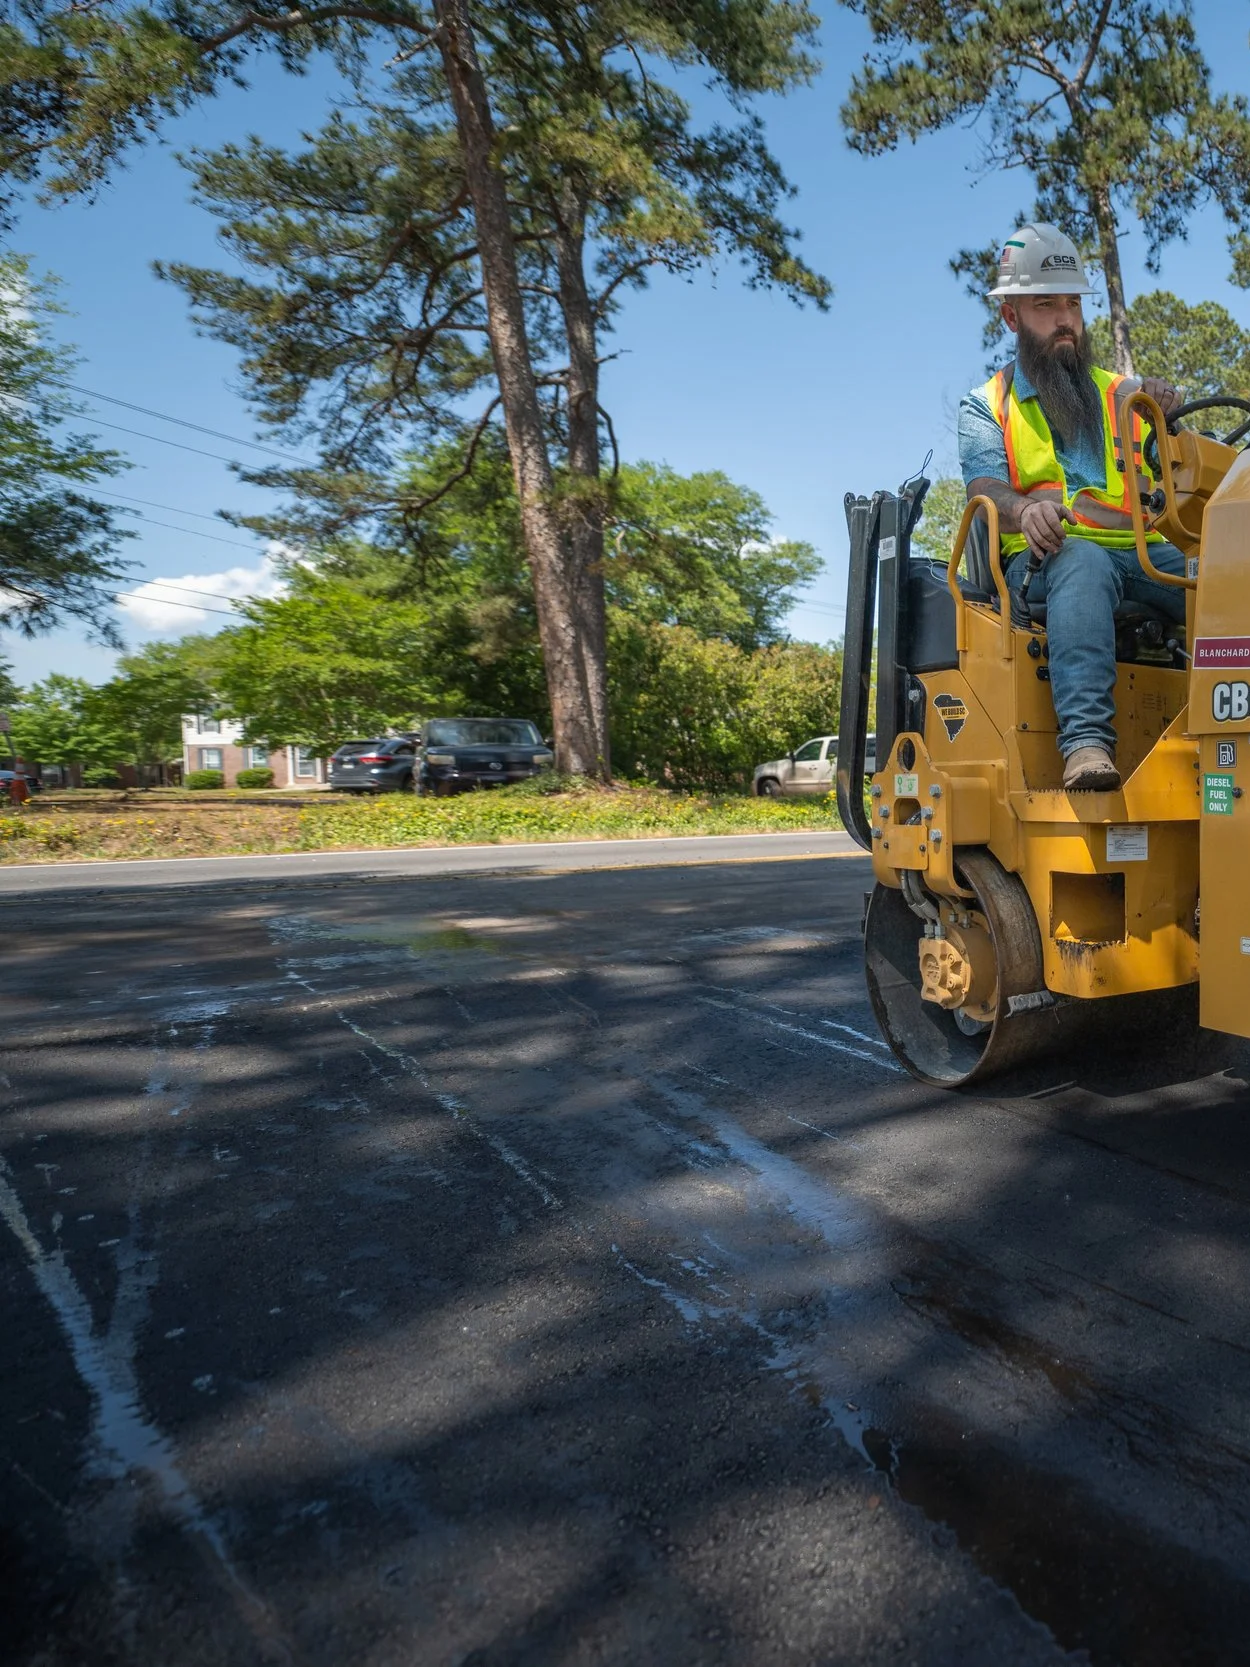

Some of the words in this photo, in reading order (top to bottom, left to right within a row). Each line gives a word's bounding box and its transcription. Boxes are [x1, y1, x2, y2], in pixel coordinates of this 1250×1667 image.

[1054, 256, 1076, 264] SCS
[1199, 648, 1250, 657] BLANCHARD
[1206, 777, 1231, 787] DIESEL
[1209, 790, 1228, 799] FUEL
[1209, 802, 1228, 812] ONLY
